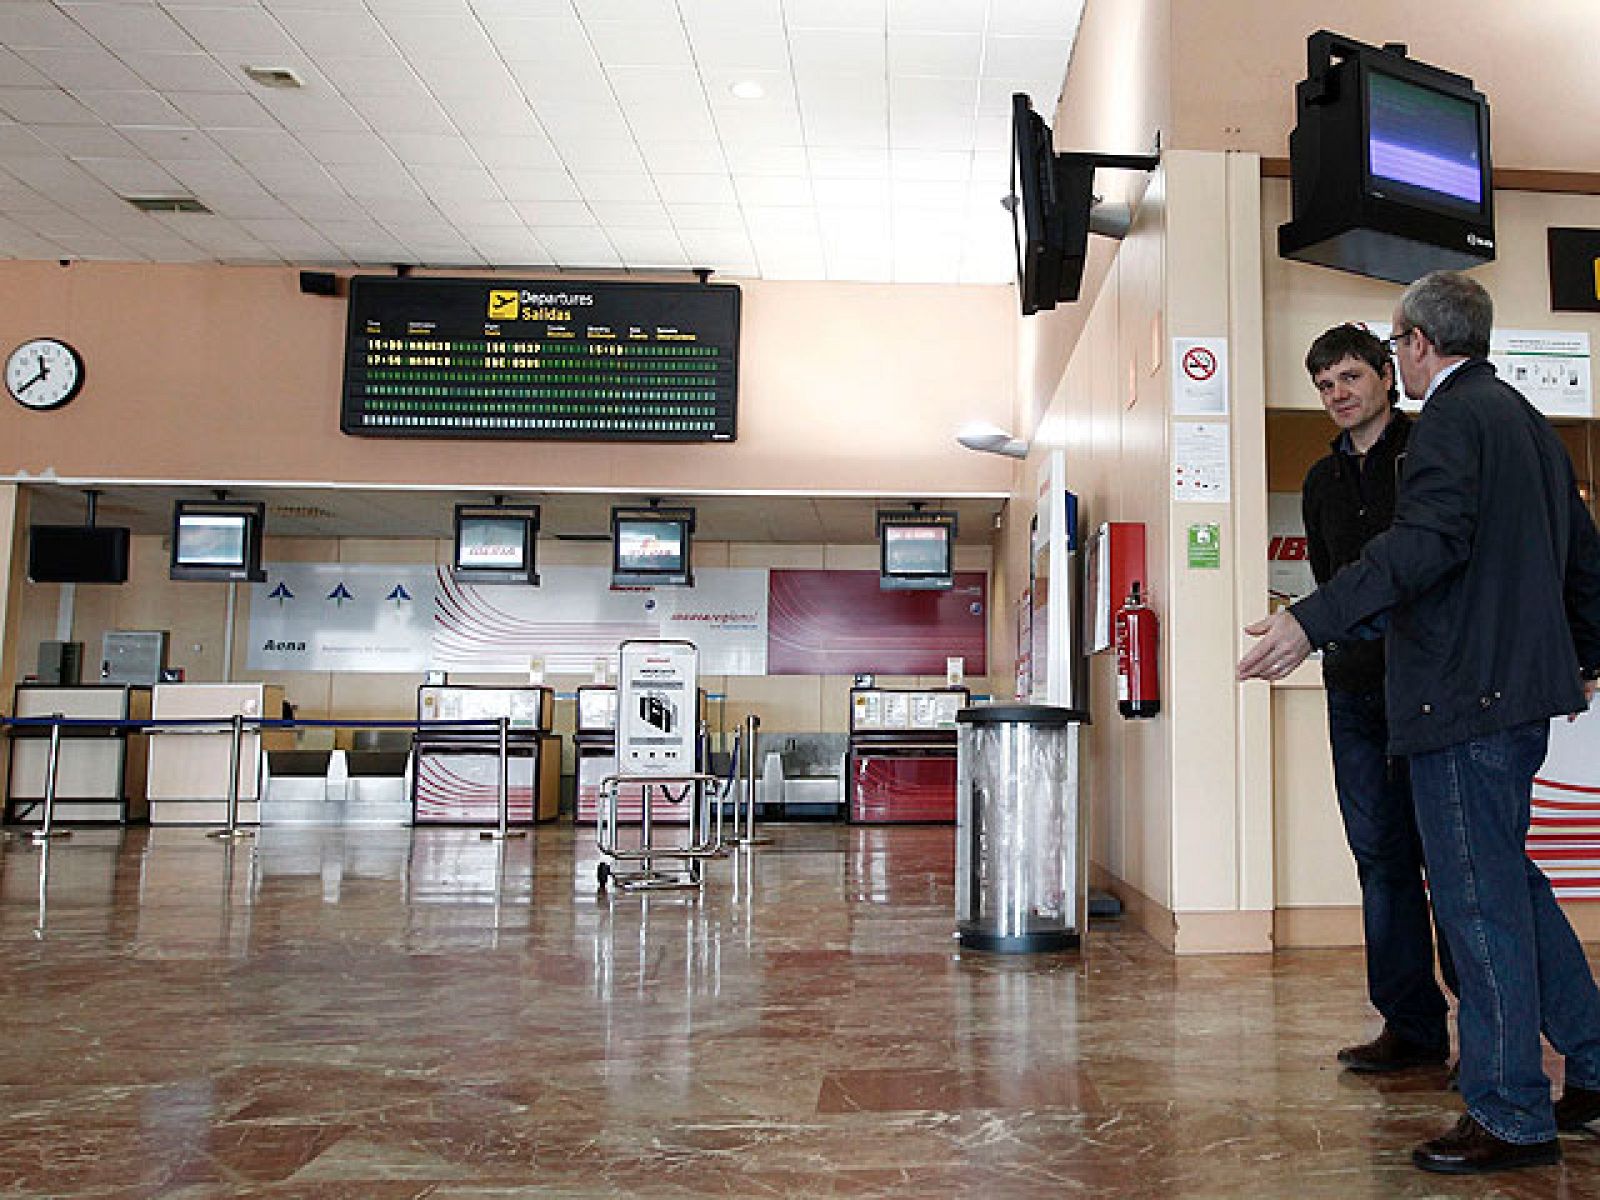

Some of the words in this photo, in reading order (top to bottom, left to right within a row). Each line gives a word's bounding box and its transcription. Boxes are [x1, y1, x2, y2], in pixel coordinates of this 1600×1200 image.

[521, 290, 594, 307] Departures
[521, 307, 571, 321] Salidas
[262, 639, 306, 652] Aena
